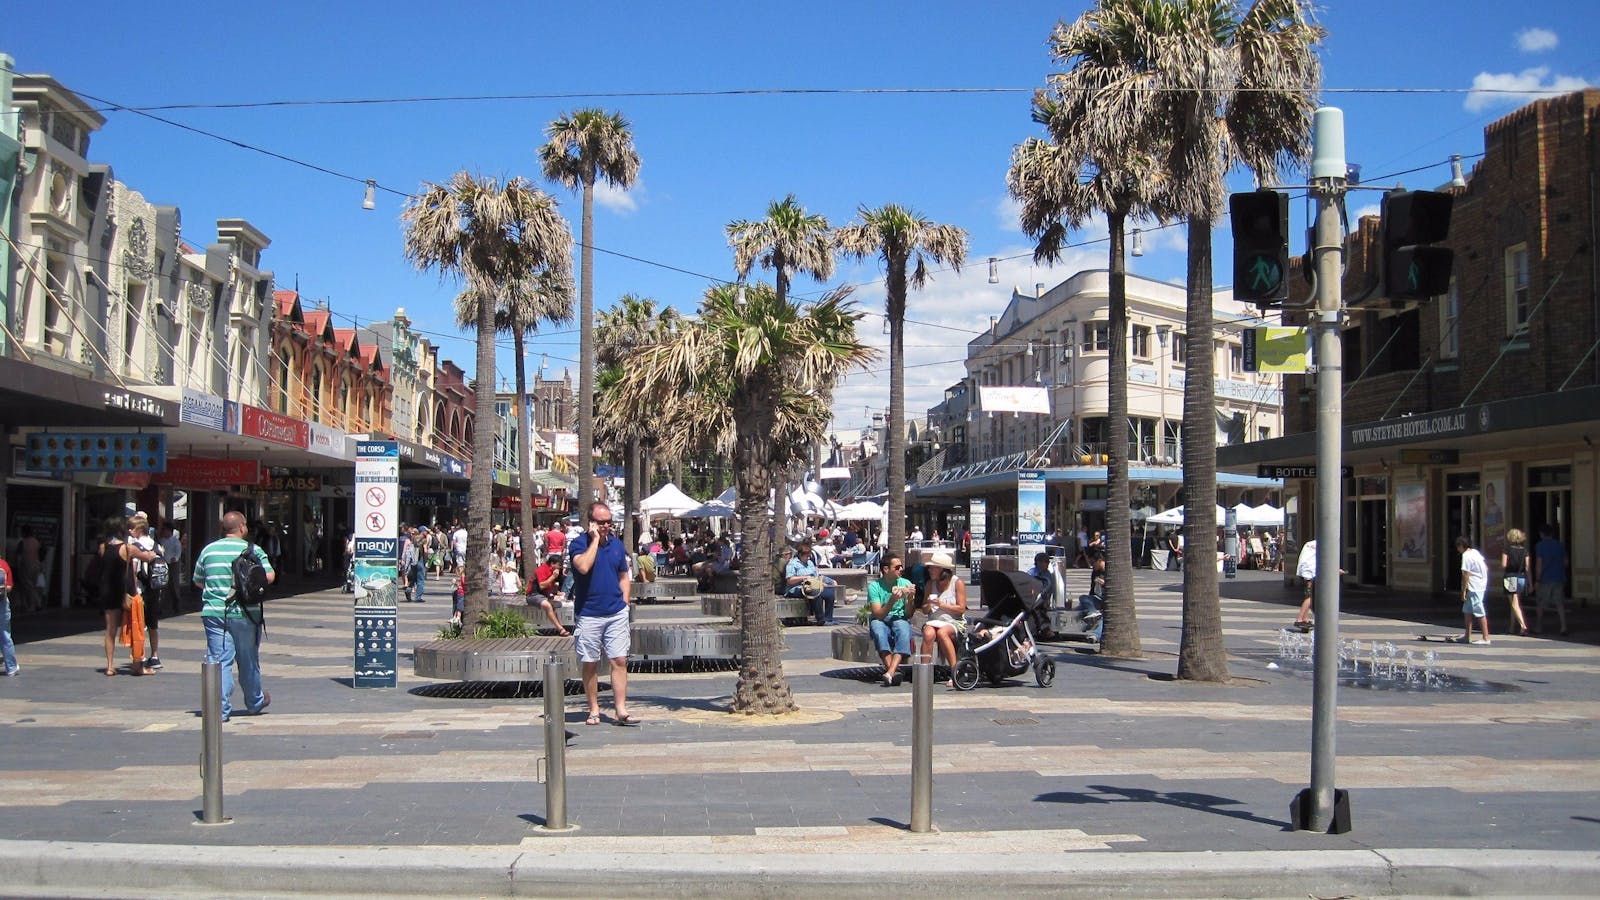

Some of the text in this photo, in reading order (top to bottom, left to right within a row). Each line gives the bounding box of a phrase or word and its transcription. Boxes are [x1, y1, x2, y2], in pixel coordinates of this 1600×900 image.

[1275, 467, 1315, 477] BOTTLE
[1020, 532, 1044, 542] manly
[357, 541, 394, 553] manly
